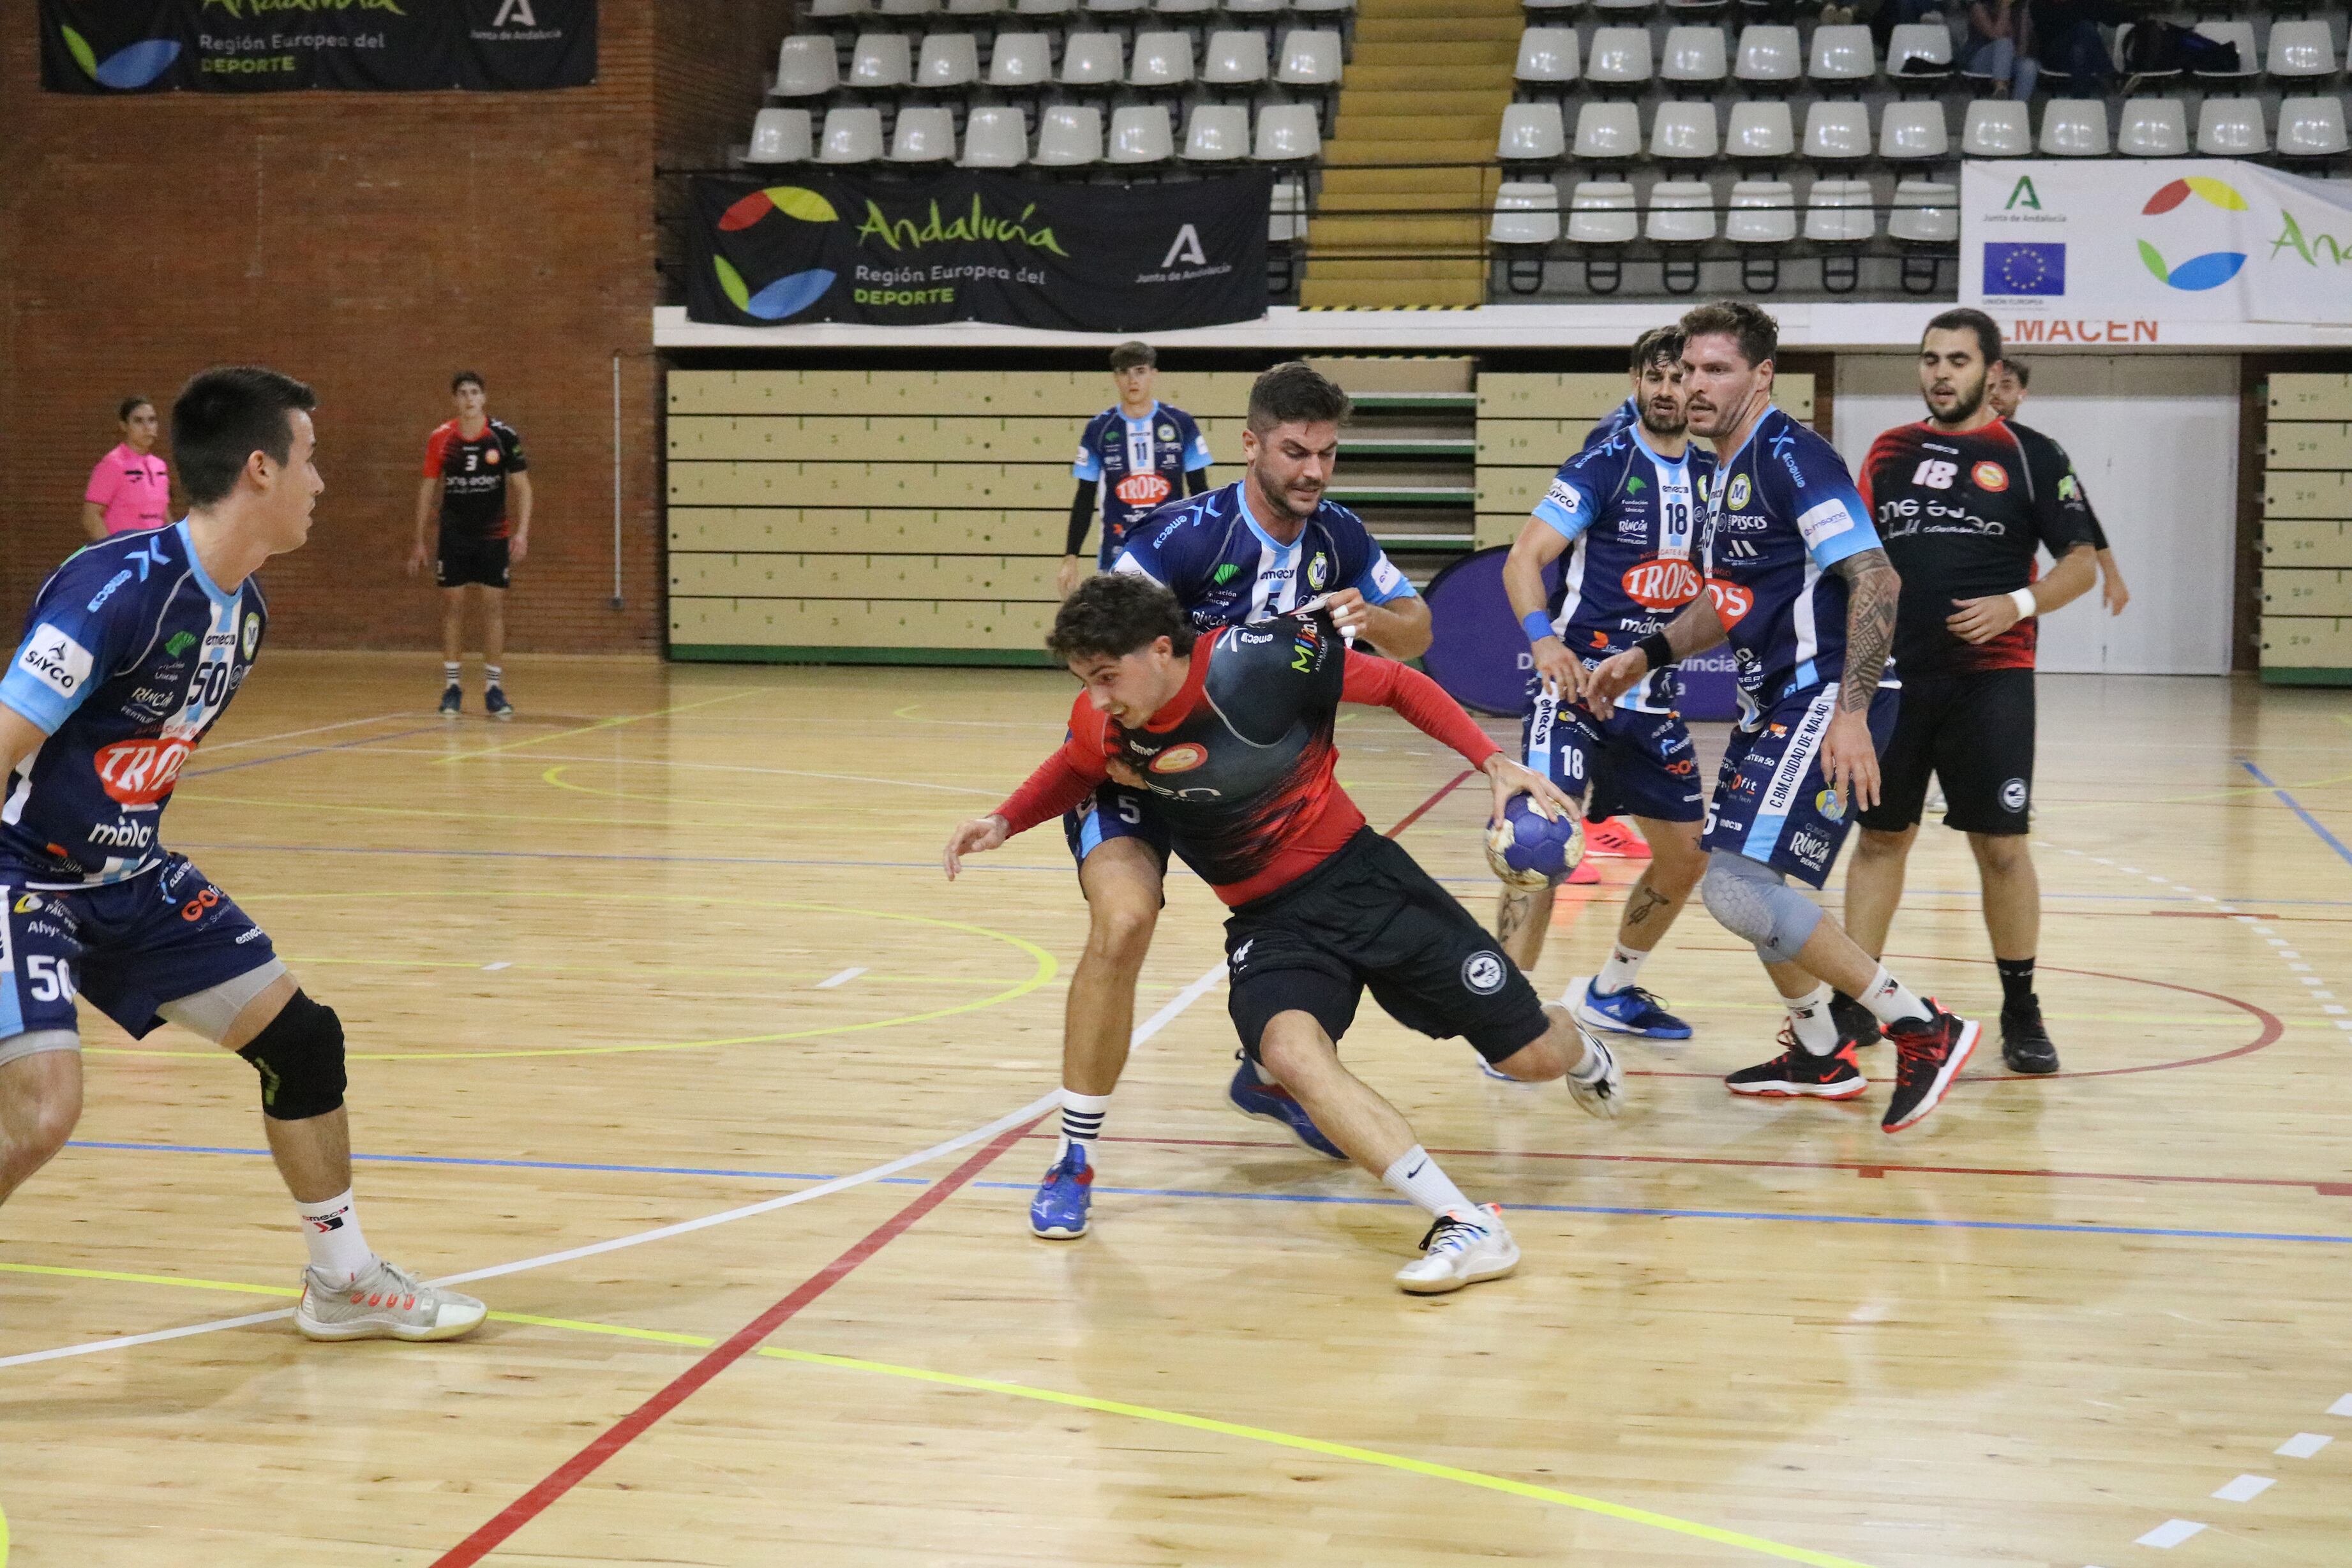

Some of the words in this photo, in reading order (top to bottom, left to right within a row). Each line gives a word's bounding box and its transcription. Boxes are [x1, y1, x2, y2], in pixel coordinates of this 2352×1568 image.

[200, 34, 266, 54] Región
[271, 34, 348, 50] Europea
[354, 32, 384, 48] del
[201, 56, 295, 73] DEPORTE
[856, 192, 1070, 257] Andalucía
[856, 265, 924, 287] Región
[931, 265, 1010, 281] Europea
[1016, 266, 1046, 285] del
[854, 288, 954, 306] DEPORTE
[2004, 320, 2158, 342] MACEN
[465, 454, 478, 472] 3
[1134, 442, 1148, 461] 11
[1911, 458, 1959, 490] 18
[1120, 476, 1168, 500] TROPS
[1549, 489, 1575, 509] AYCO
[1665, 502, 1688, 535] 18
[1628, 562, 1699, 600] TROPS
[25, 650, 74, 689] SAYCO
[186, 662, 228, 707] 50
[1561, 745, 1584, 780] 18
[1744, 753, 1764, 764] STER
[1764, 757, 1775, 767] 50
[1769, 747, 1807, 809] C.BM.CIUDAD
[1797, 733, 1814, 749] DE
[1118, 795, 1141, 825] 5
[1799, 856, 1822, 872] DENTAL
[26, 954, 78, 1004] 50
